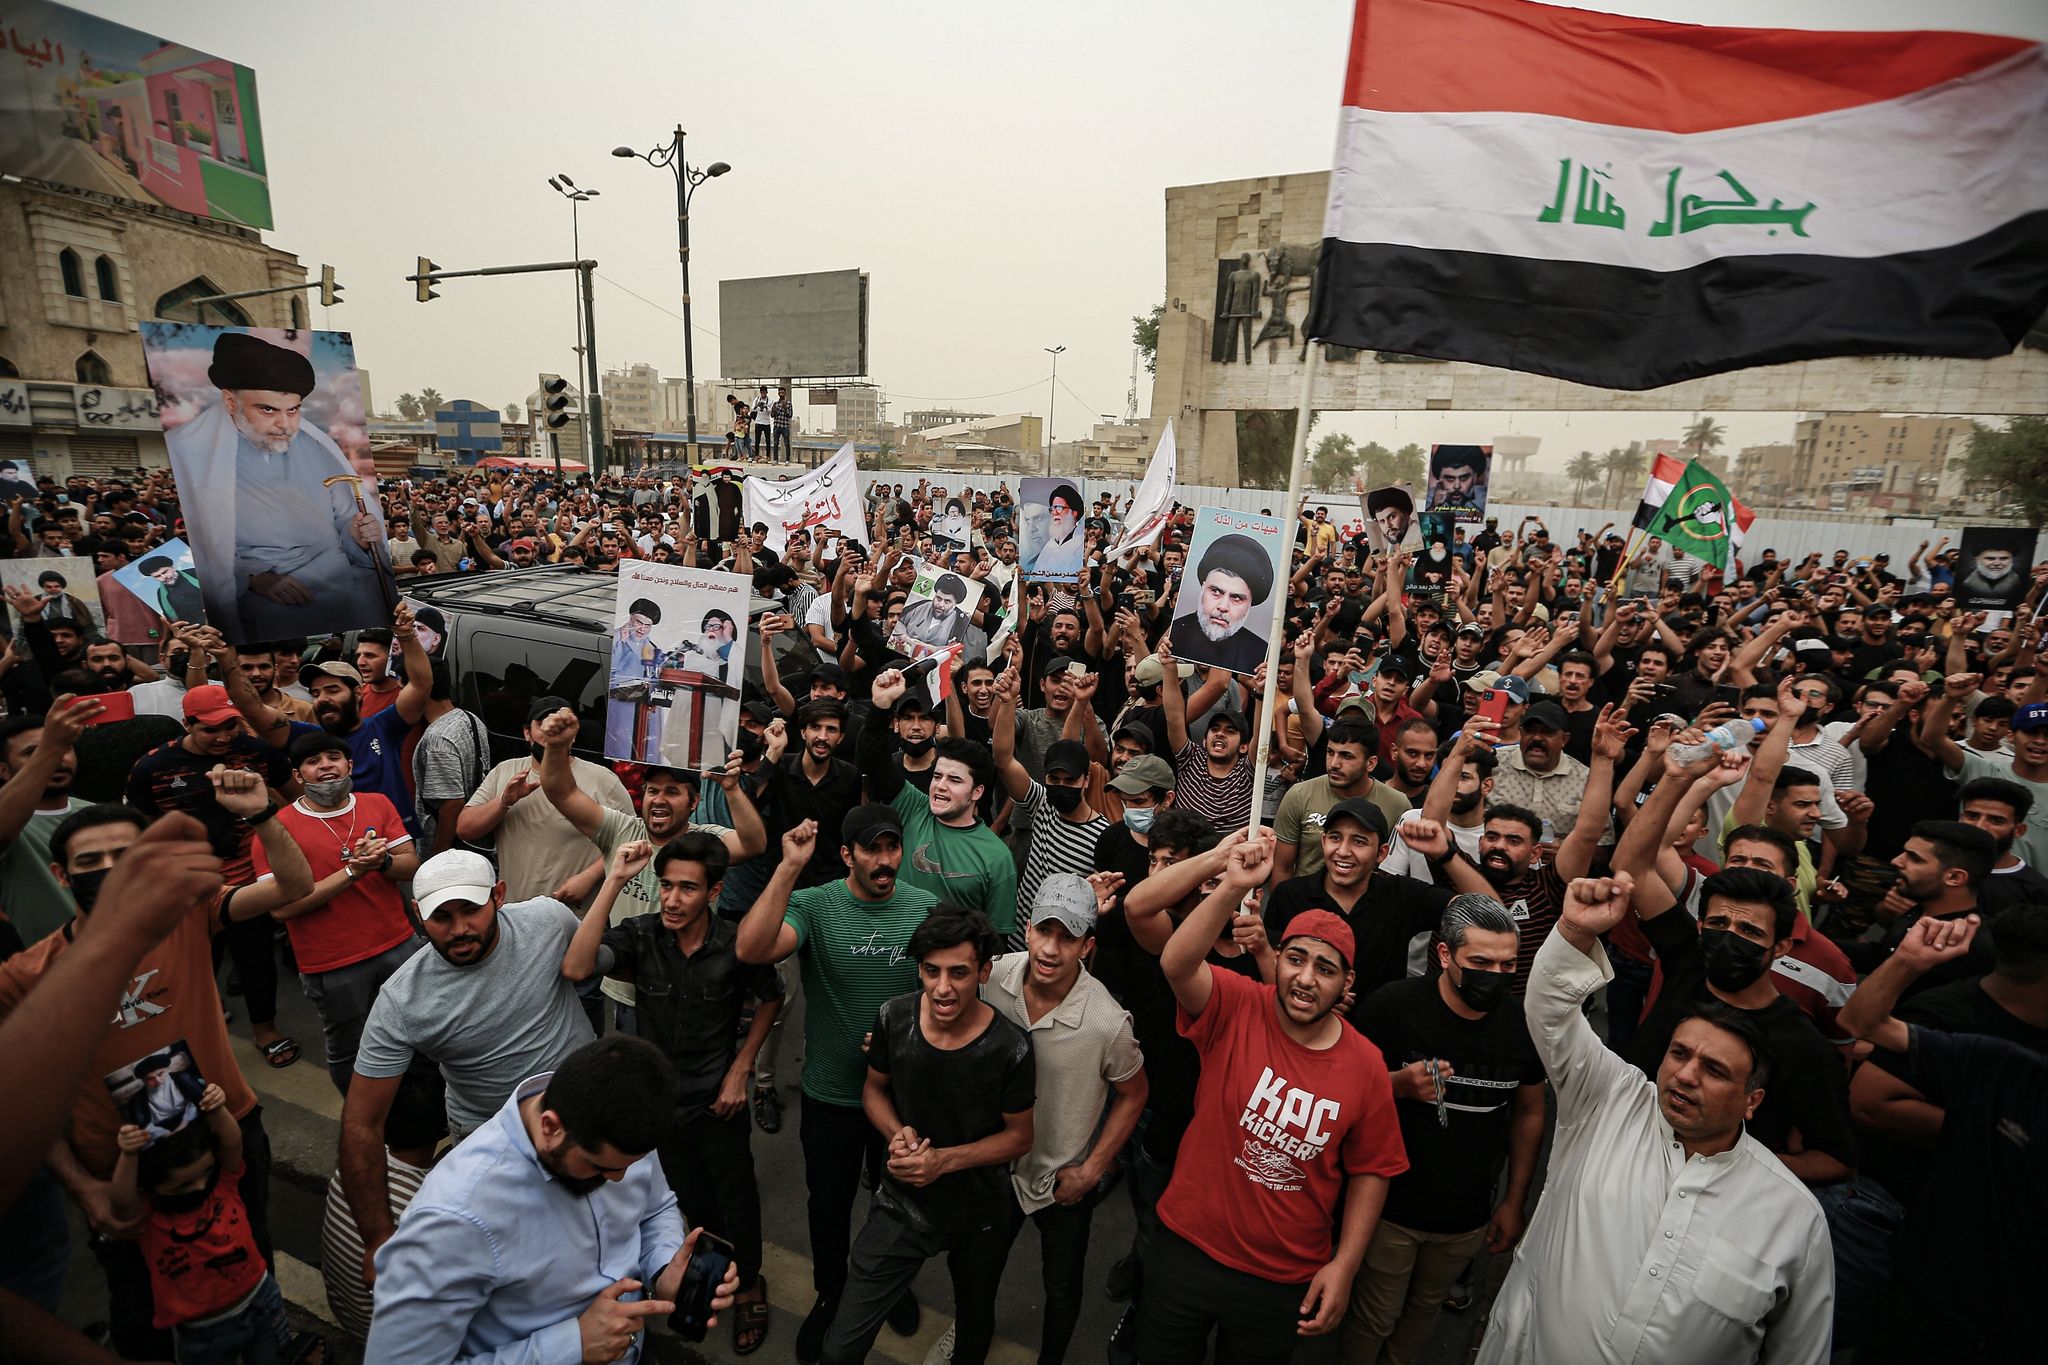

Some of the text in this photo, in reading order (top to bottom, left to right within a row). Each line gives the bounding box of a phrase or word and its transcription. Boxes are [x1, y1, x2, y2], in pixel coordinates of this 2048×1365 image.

[1234, 520, 1248, 530] من
[1251, 522, 1279, 534] هيهات
[1022, 569, 1046, 577] الشجاع
[640, 574, 654, 582] معنا
[654, 576, 669, 586] ونحن
[669, 579, 692, 588] والسلاح
[707, 584, 727, 592] معهم
[1405, 583, 1418, 591] صالح
[727, 586, 739, 594] هم
[2029, 709, 2048, 718] BT
[120, 998, 145, 1012] alvin
[1465, 1078, 1479, 1086] NICE
[1247, 1066, 1341, 1147] KPC
